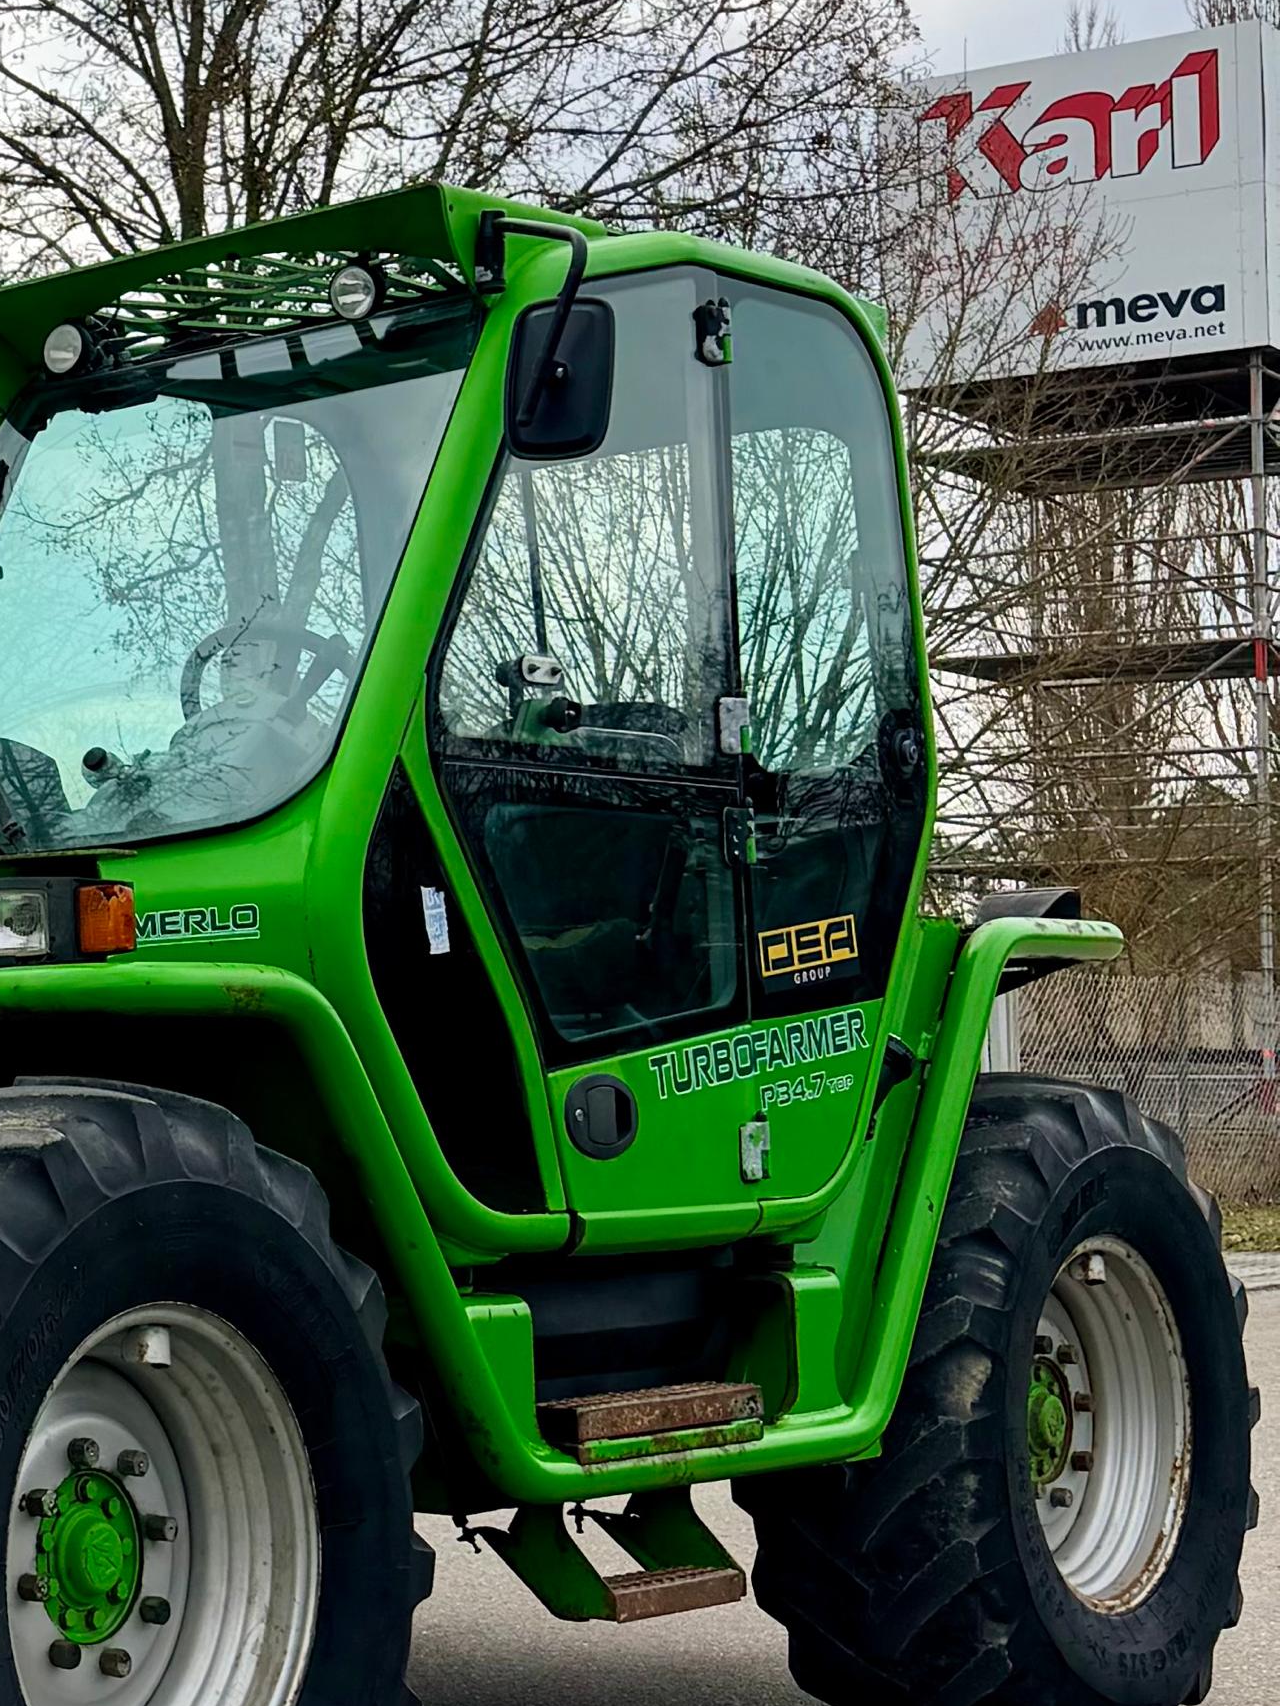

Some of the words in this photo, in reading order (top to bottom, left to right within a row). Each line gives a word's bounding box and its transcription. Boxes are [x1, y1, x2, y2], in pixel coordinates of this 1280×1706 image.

[917, 48, 1220, 208] Karl
[1077, 284, 1225, 329] meva
[1078, 321, 1226, 352] www.meva.net
[793, 965, 831, 984] GROUP
[649, 1009, 869, 1099] TURBOFARMER
[760, 1071, 826, 1111] P34.7
